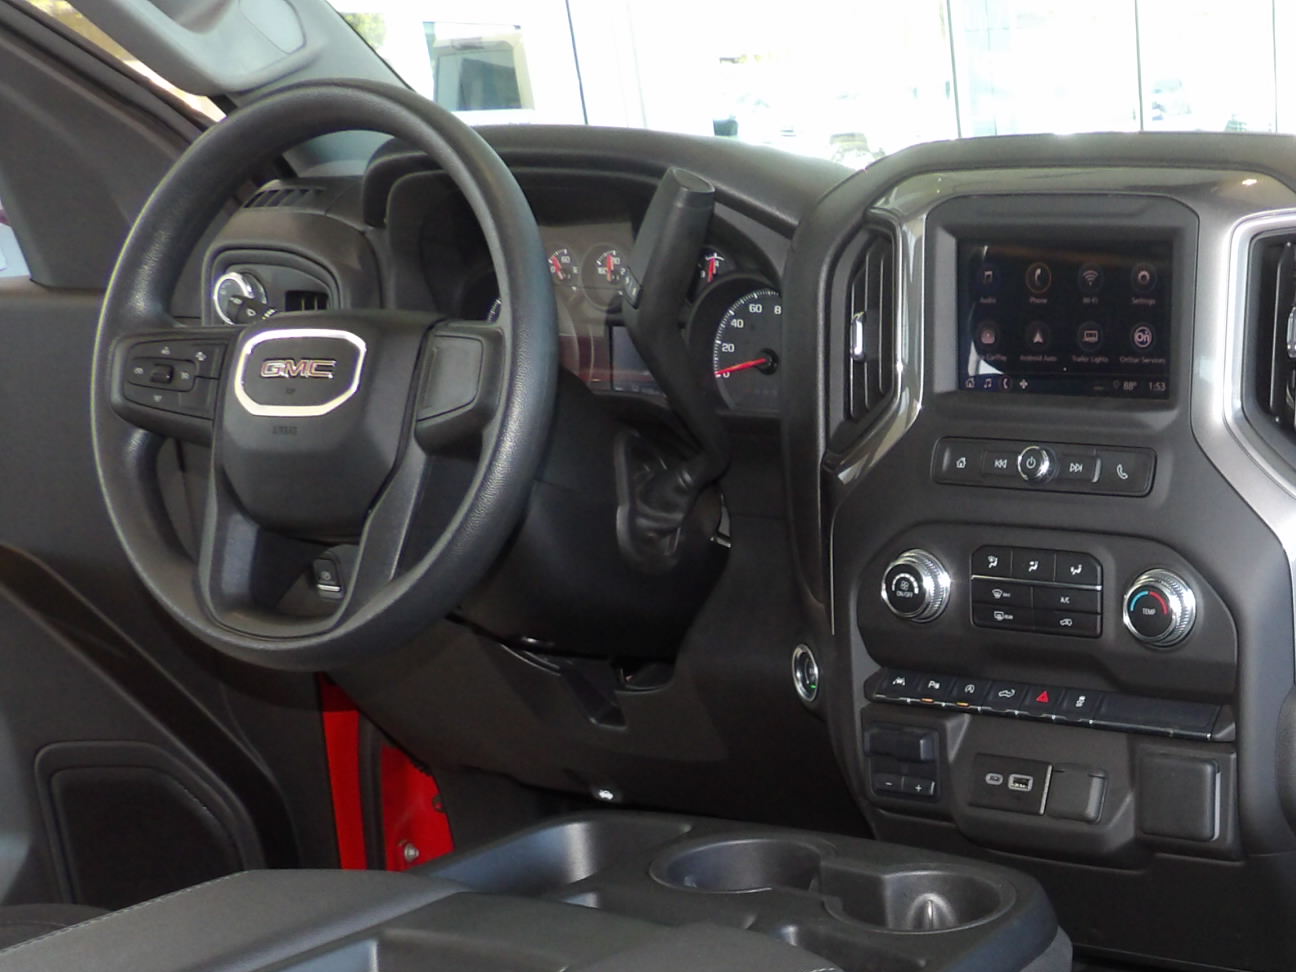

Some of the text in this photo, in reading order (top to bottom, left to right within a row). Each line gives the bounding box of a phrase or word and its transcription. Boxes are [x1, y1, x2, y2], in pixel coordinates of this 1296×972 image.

[748, 304, 763, 313] 60
[730, 319, 744, 328] 40
[721, 343, 735, 353] 20
[260, 358, 336, 379] GMC
[1149, 382, 1166, 391] 1:53
[1060, 596, 1071, 604] A/C
[1142, 607, 1157, 615] TEMP
